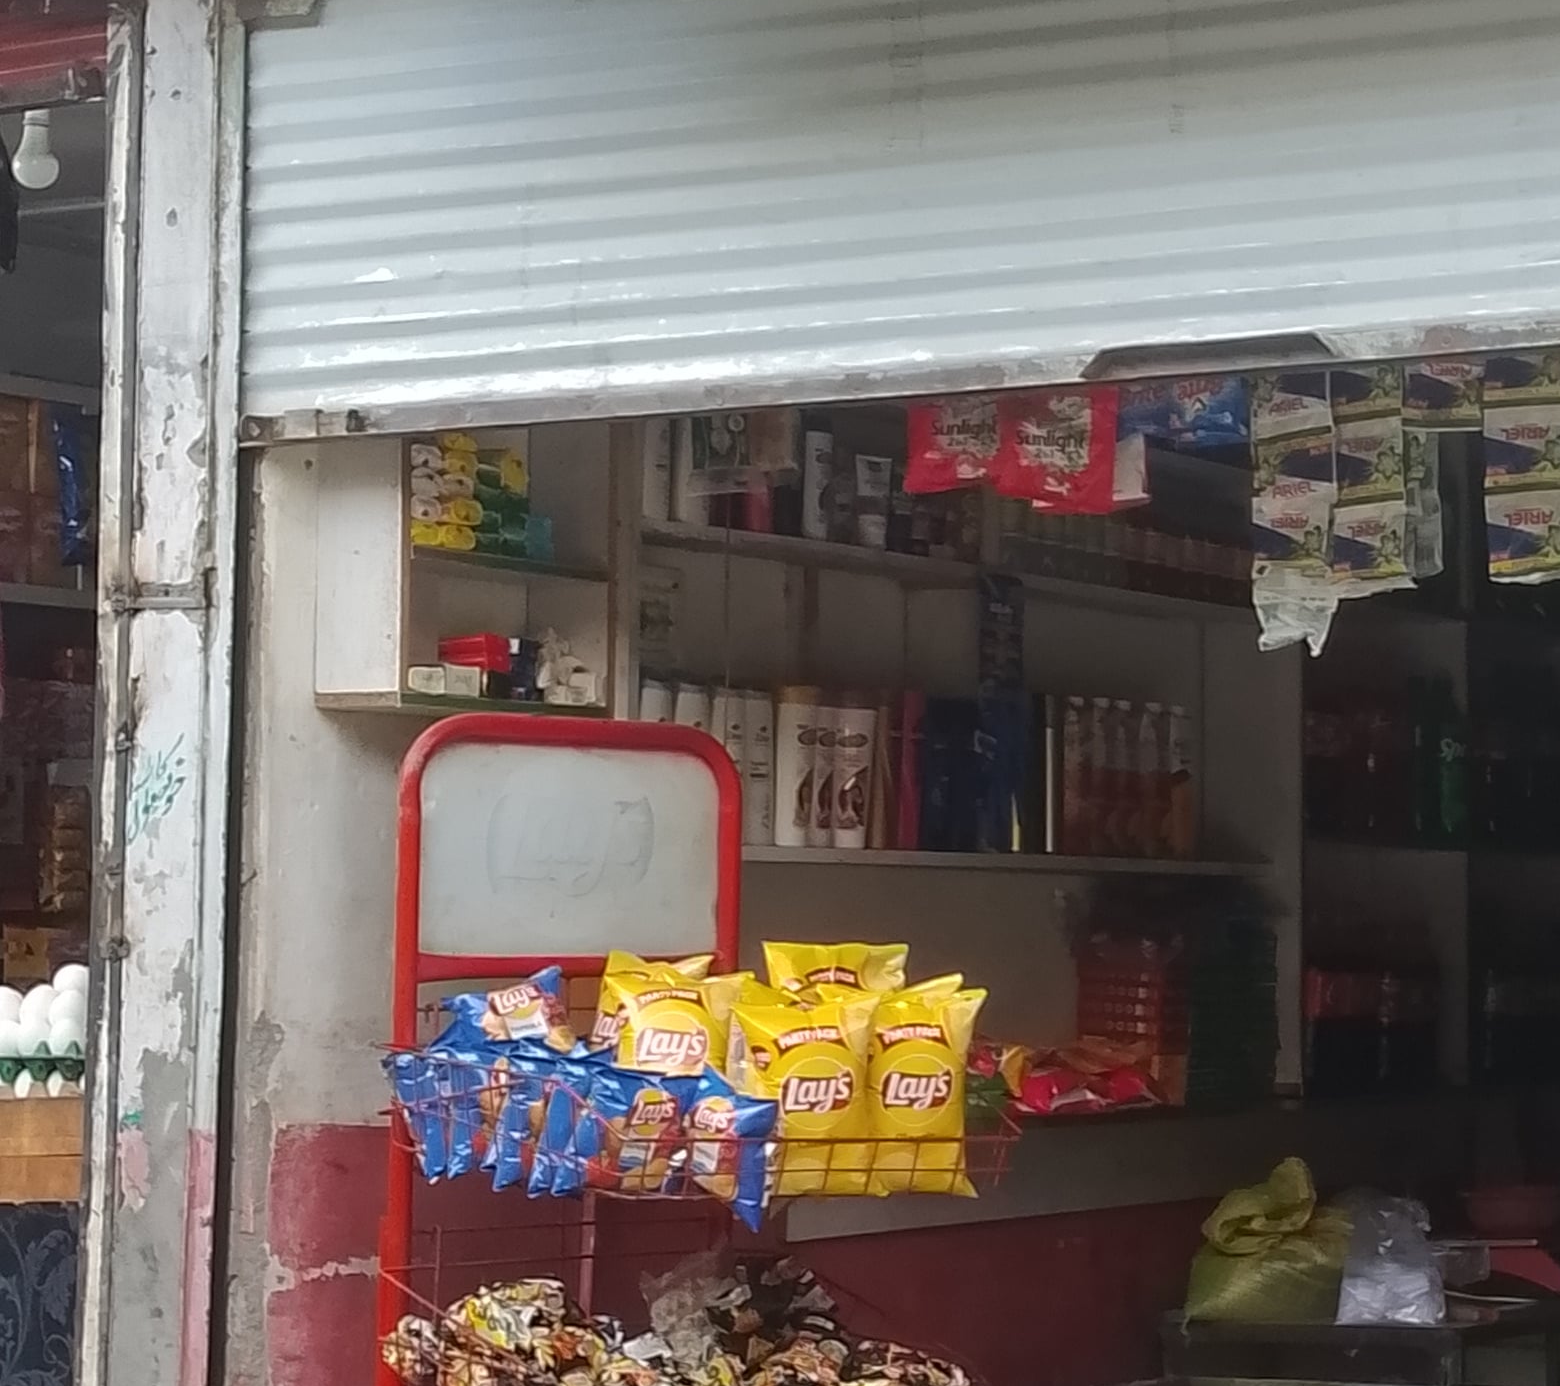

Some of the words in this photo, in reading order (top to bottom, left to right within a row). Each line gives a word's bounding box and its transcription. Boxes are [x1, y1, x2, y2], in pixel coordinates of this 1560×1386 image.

[1501, 424, 1551, 441] ARIEL
[1272, 481, 1317, 500] ARIEL
[1504, 507, 1556, 527] ARIEL
[491, 984, 540, 1014] Lay's
[637, 1026, 707, 1064] Lay's
[785, 1072, 851, 1114] Lay's
[885, 1071, 951, 1112] Lay's
[631, 1099, 676, 1127] Lay's
[693, 1103, 732, 1133] Lay's
